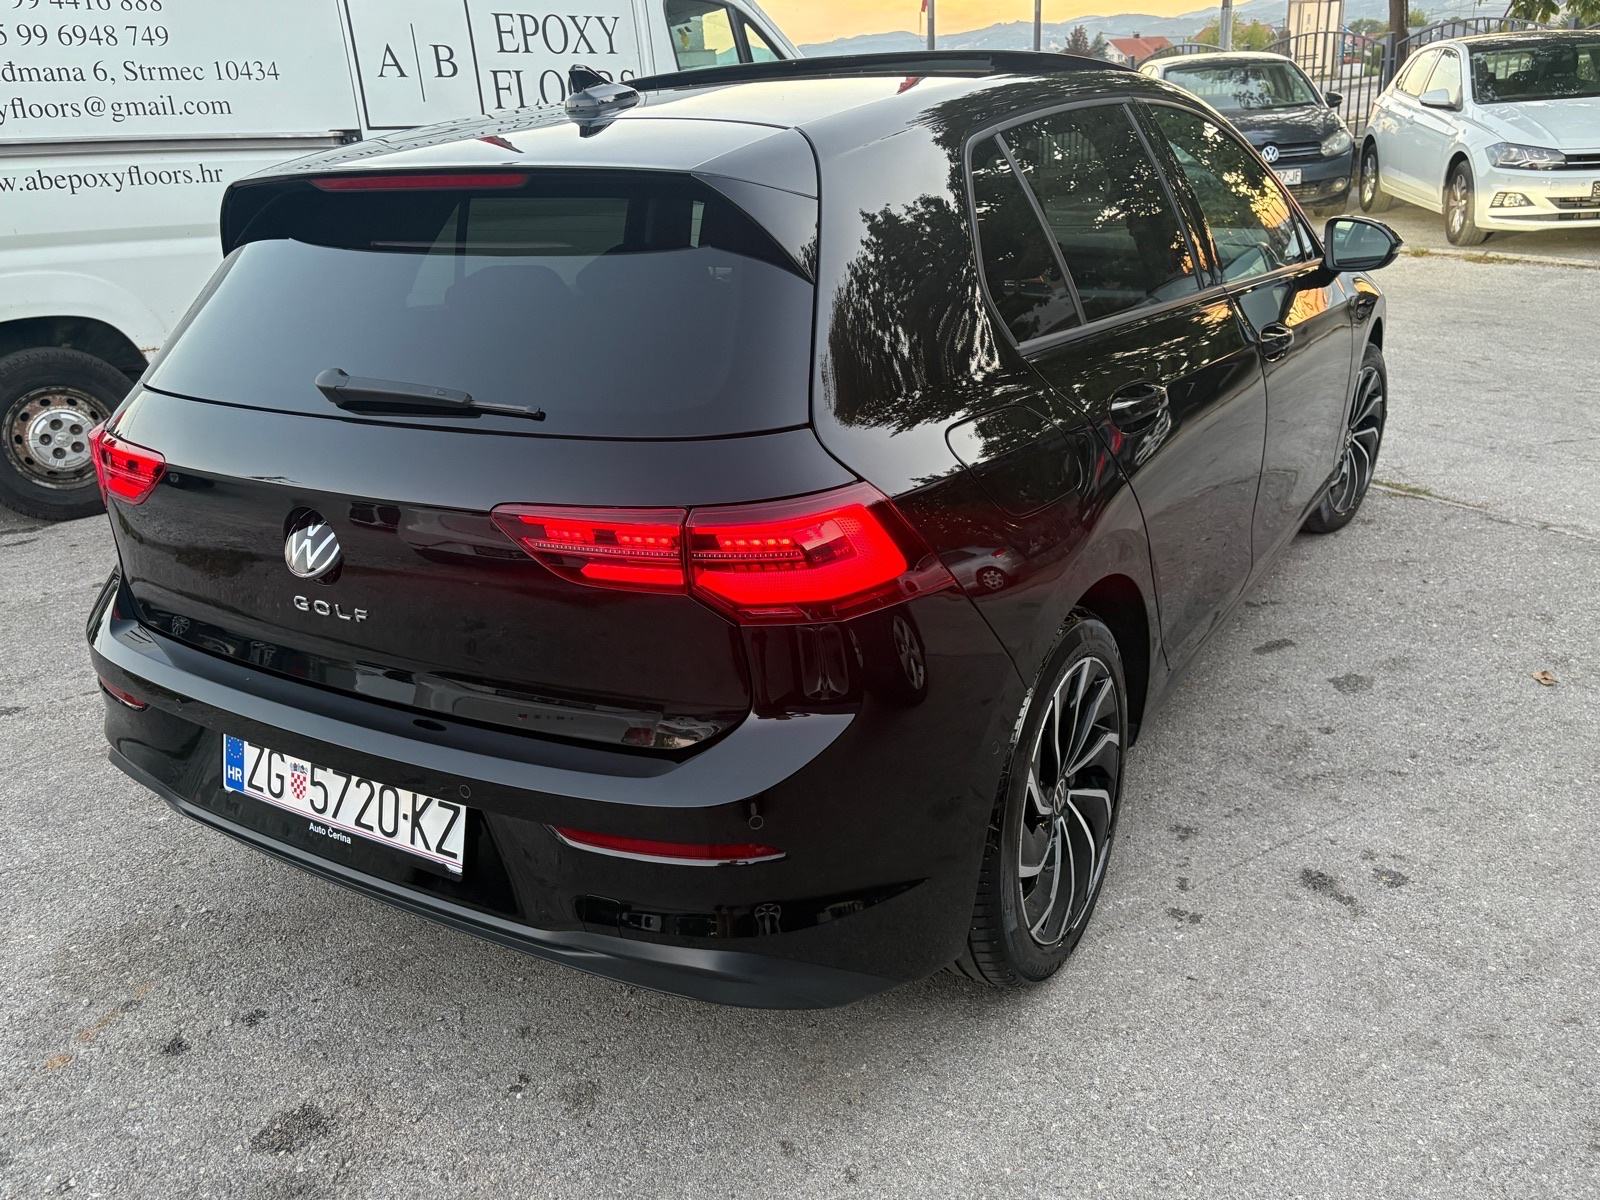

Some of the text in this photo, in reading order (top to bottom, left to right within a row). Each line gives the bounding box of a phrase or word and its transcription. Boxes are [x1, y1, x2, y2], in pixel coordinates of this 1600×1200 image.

[16, 23, 48, 47] 99
[57, 24, 118, 47] 6948
[124, 25, 169, 47] 749
[490, 12, 620, 55] EPOXY
[93, 60, 116, 85] 6,
[124, 60, 206, 83] Strmec
[214, 60, 281, 82] 10434
[377, 42, 459, 79] A B
[489, 69, 636, 110] FLO
[293, 595, 369, 623] GOLF
[227, 764, 243, 783] HR
[247, 743, 286, 800] ZG
[308, 822, 352, 845] Auto Čerina
